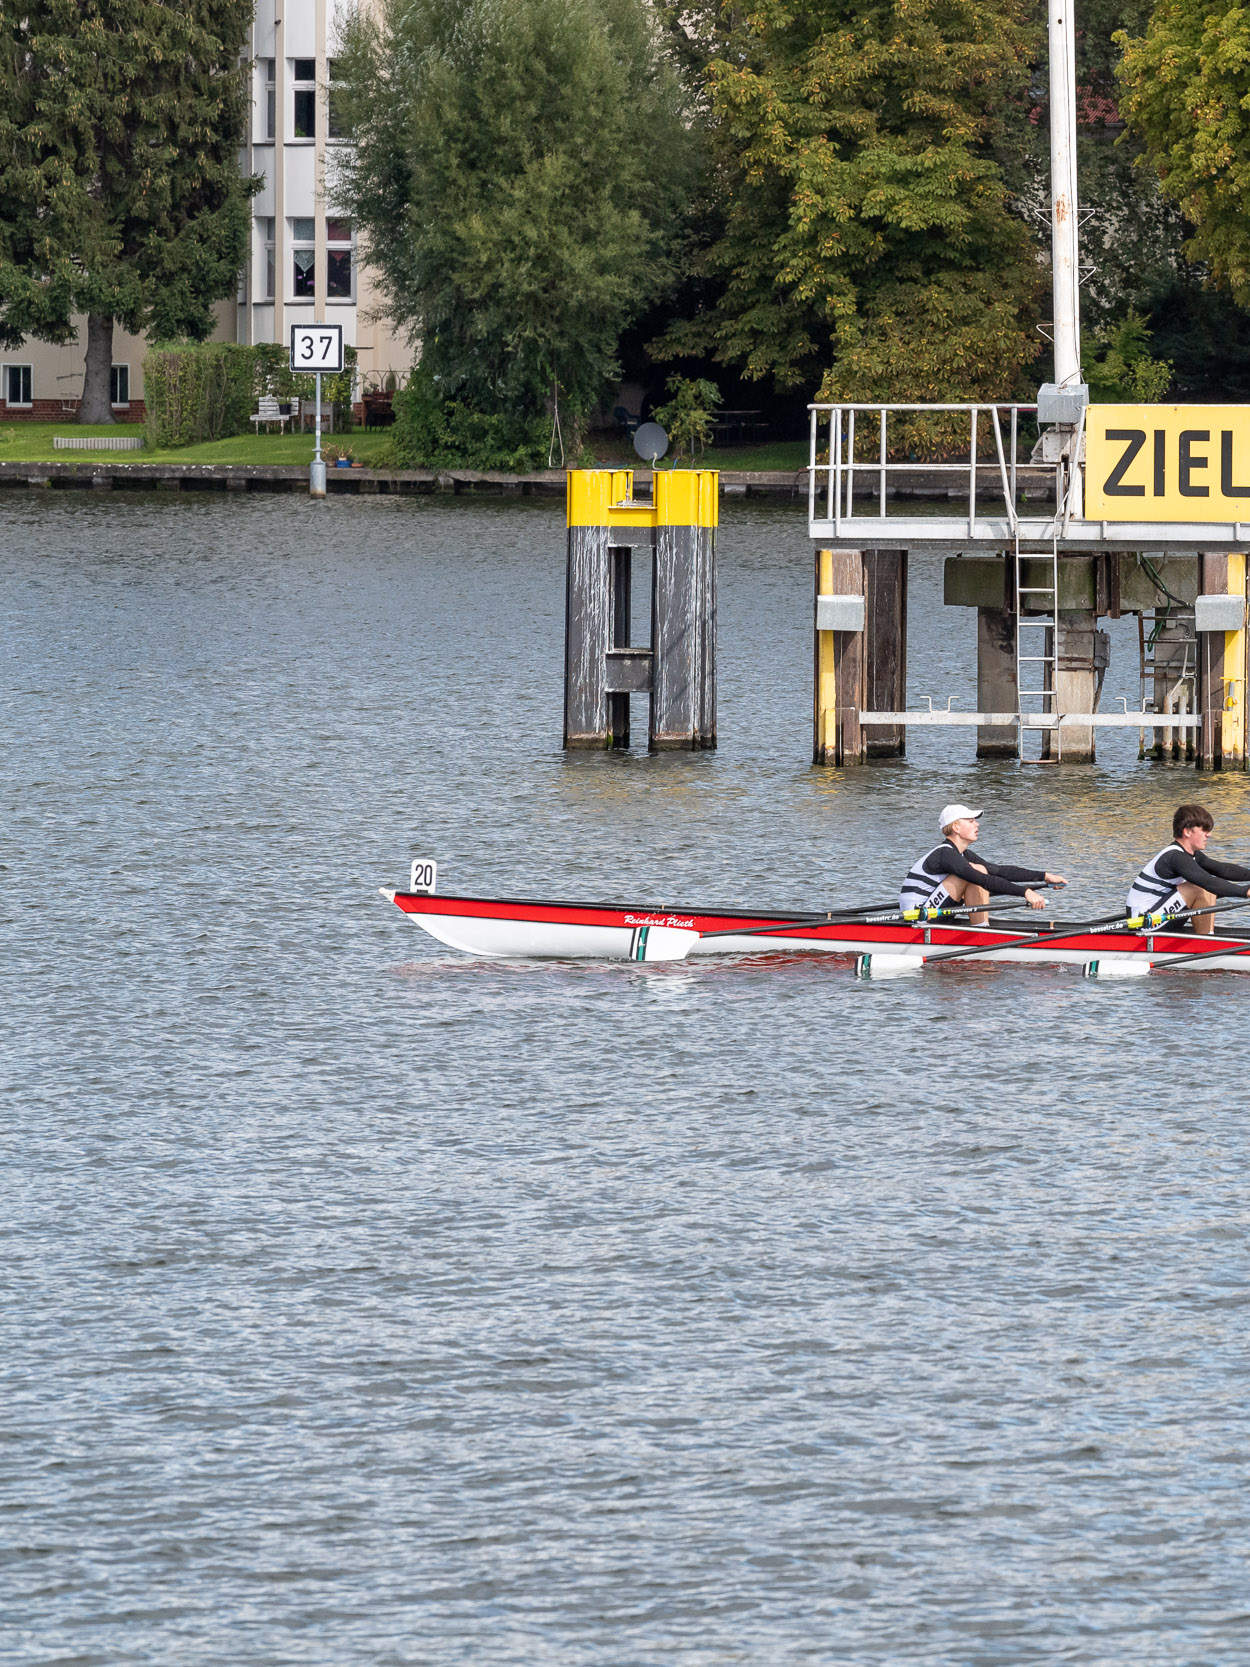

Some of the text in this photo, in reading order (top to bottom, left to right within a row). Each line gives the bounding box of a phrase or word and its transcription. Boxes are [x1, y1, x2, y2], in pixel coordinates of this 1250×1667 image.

[301, 335, 333, 360] 37
[414, 864, 433, 887] 20
[624, 914, 665, 926] Reinhard
